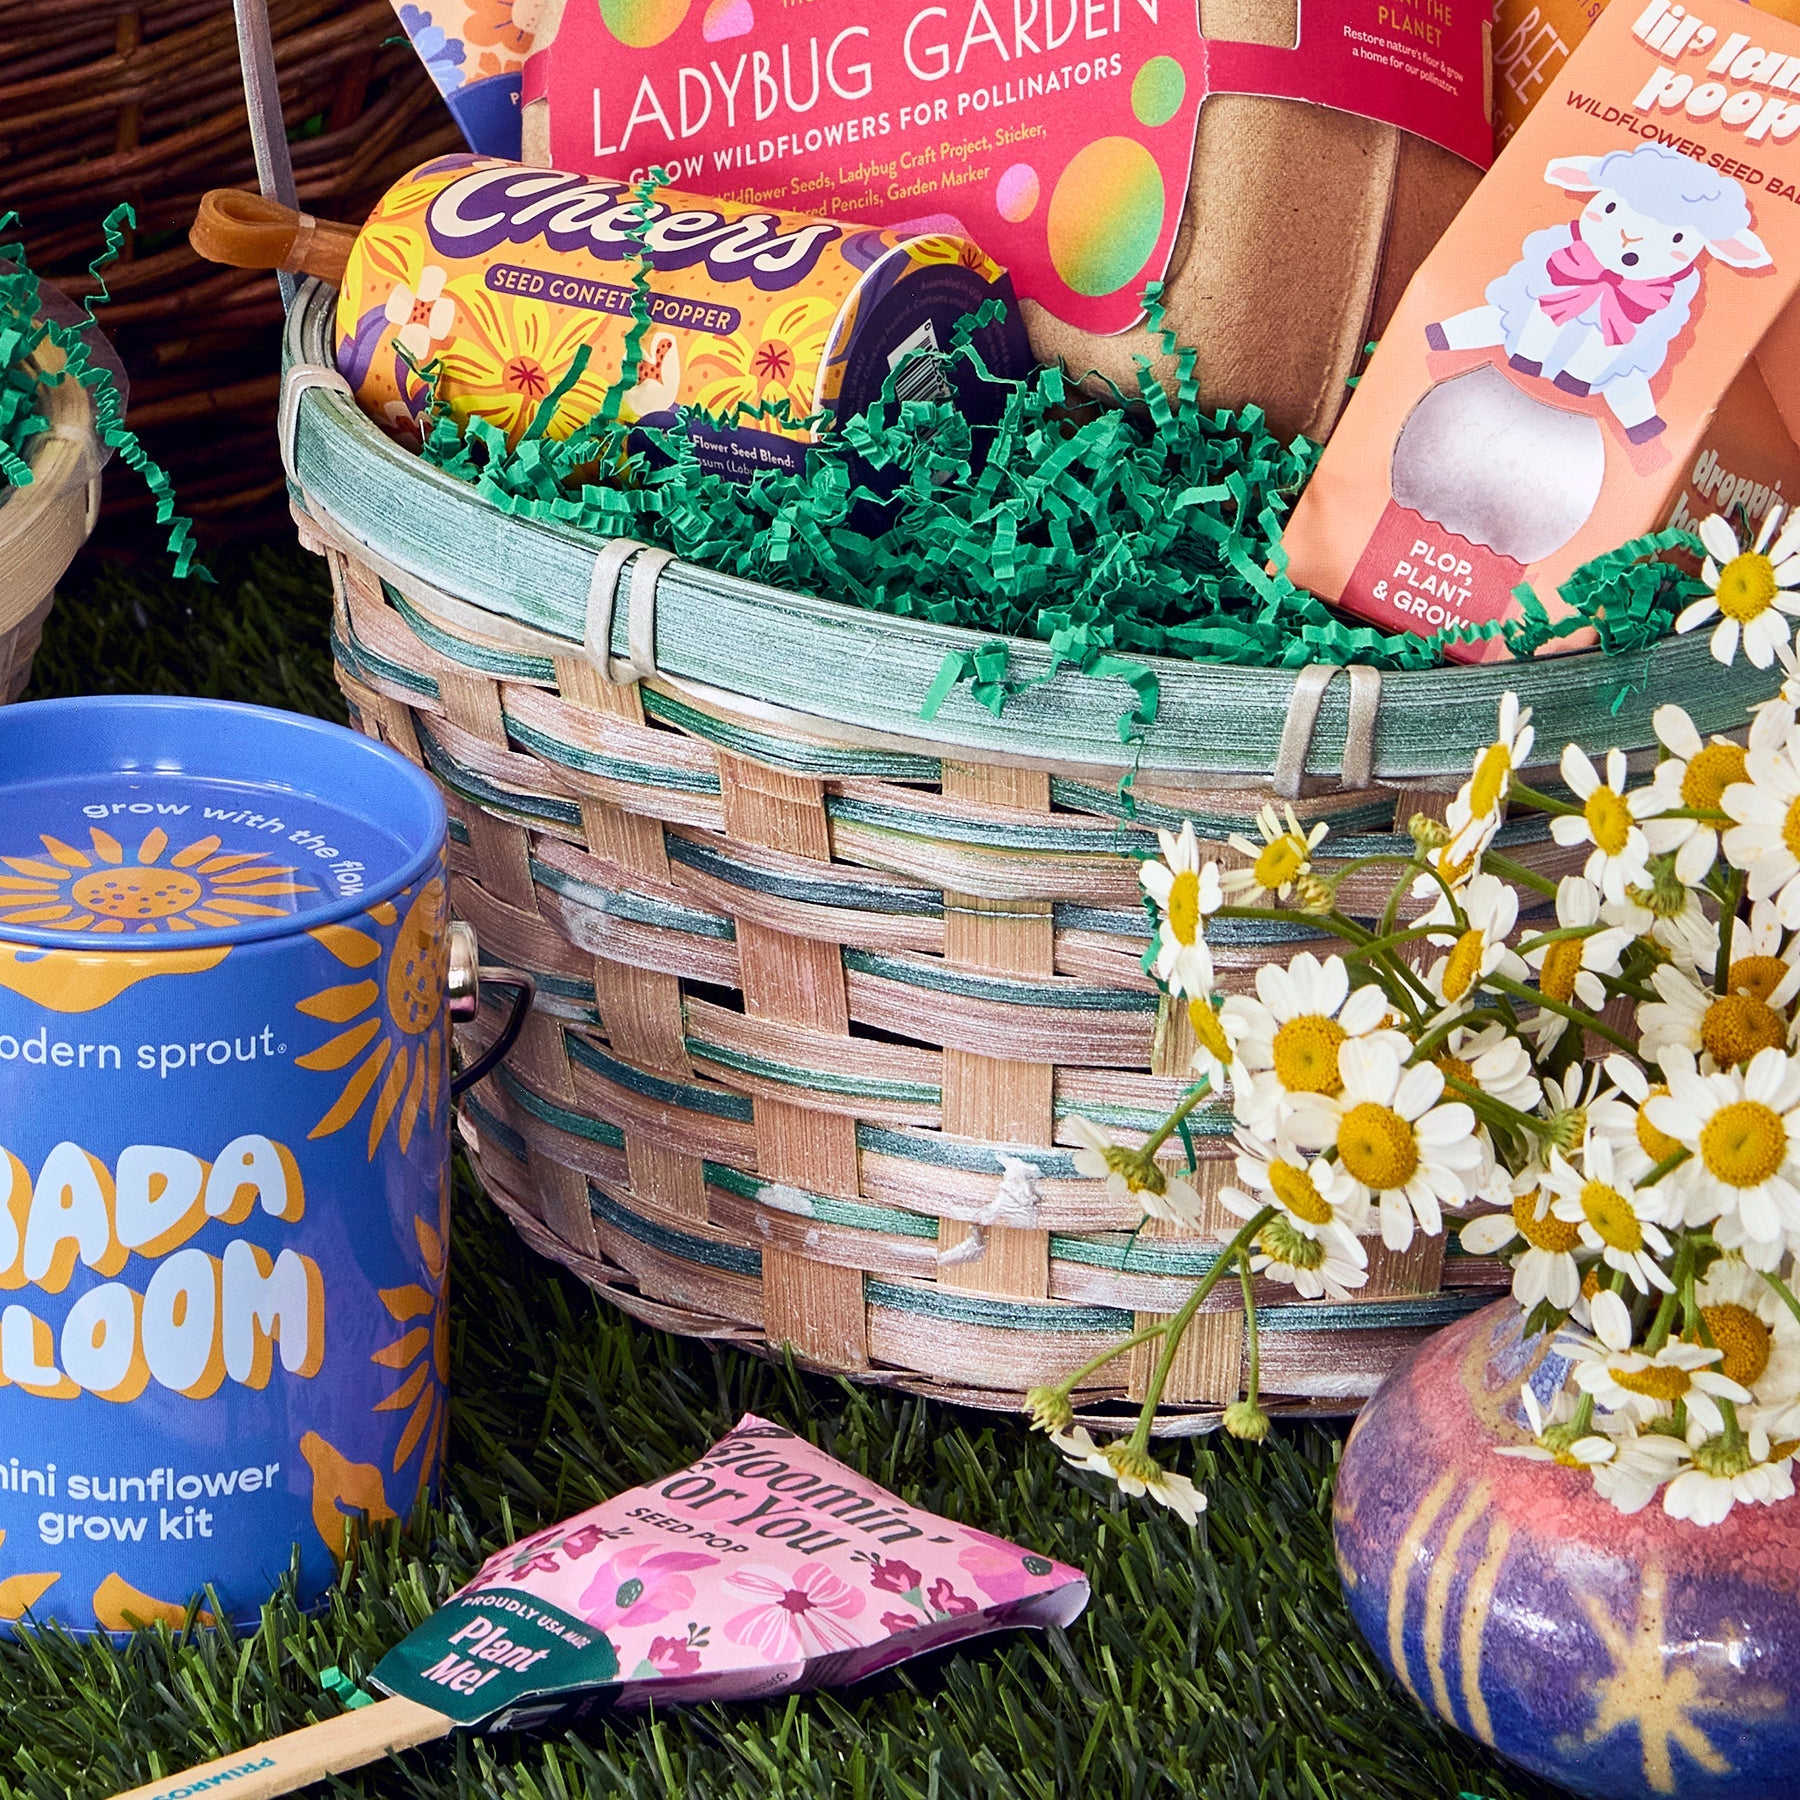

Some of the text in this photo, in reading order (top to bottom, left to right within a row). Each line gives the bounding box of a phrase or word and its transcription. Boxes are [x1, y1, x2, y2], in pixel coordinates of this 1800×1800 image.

[1343, 25, 1386, 48] Restore
[1386, 40, 1422, 61] nature's
[1379, 5, 1443, 49] PLANET
[1352, 47, 1359, 57] a
[1360, 46, 1389, 65] home
[1389, 55, 1404, 69] for
[1405, 63, 1420, 76] our
[1494, 5, 1571, 105] BEE
[592, 24, 873, 158] LADYBUG
[713, 53, 1124, 175] WILDFLOWERS FOR POLLINATORS
[1632, 65, 1800, 141] poop
[790, 123, 1047, 195] Seeds, Ladybug Craft Project, Sticker,
[1567, 90, 1707, 161] WILDFLOWER
[1707, 153, 1764, 185] SEED
[831, 164, 991, 217] Pencils, Garden Marker
[427, 163, 838, 280] Cheers
[493, 268, 733, 330] SEED POPPER
[692, 434, 729, 454] Flower
[731, 443, 758, 459] Seed
[760, 449, 796, 468] Blend:
[1393, 562, 1473, 607] PLANT
[1409, 539, 1474, 586] PLOP,
[1372, 581, 1470, 632] & GROW
[82, 802, 366, 897] grow with the flow
[66, 1459, 281, 1505] sunflower
[38, 1506, 214, 1546] grow kit
[625, 1507, 750, 1554] SEED POP
[728, 1494, 851, 1556] You
[460, 1593, 541, 1628] PROUDLY
[538, 1614, 567, 1639] USA
[448, 1615, 549, 1674] Plant
[420, 1651, 500, 1697] Me!
